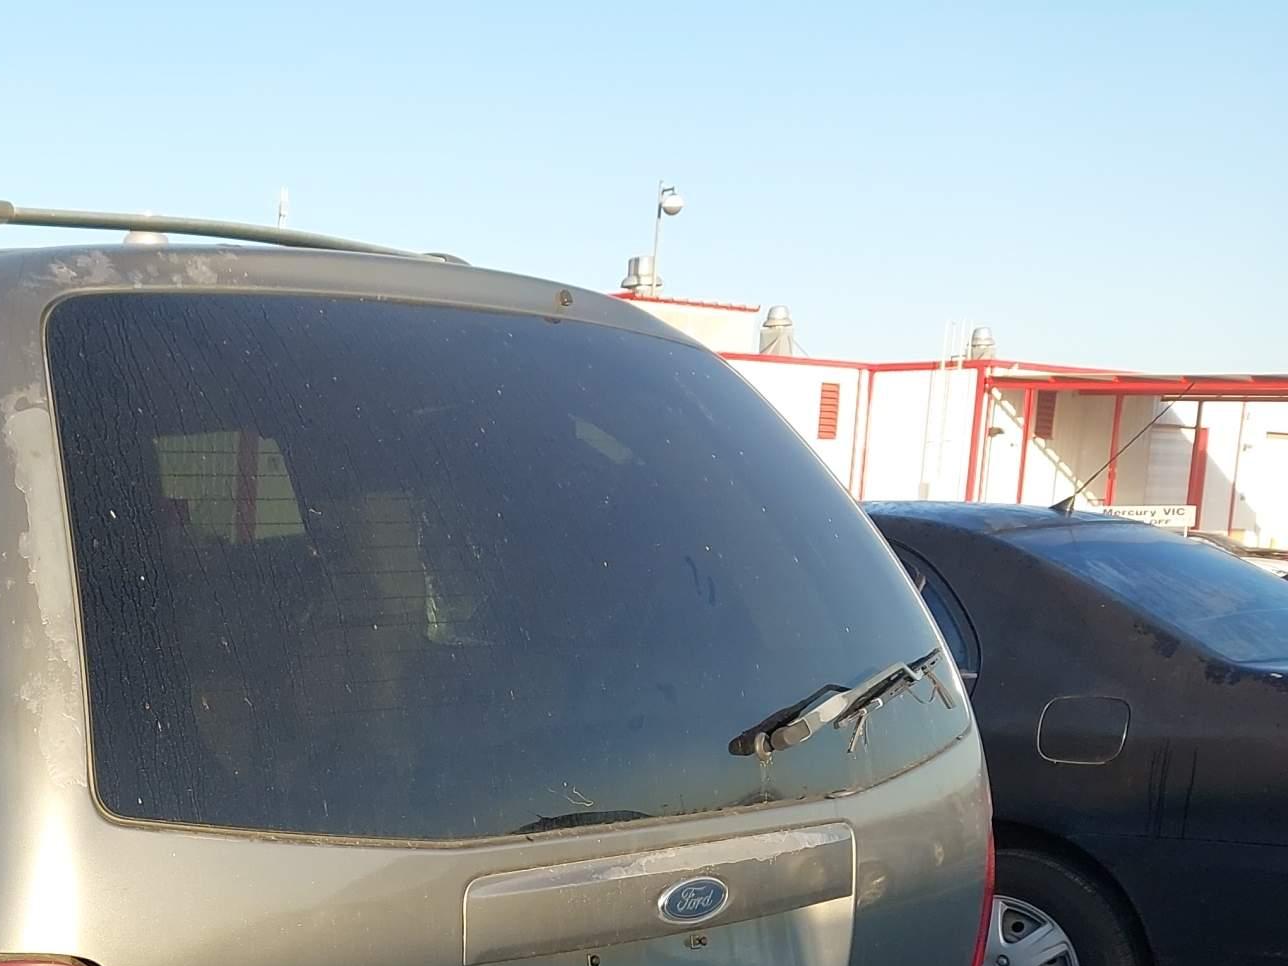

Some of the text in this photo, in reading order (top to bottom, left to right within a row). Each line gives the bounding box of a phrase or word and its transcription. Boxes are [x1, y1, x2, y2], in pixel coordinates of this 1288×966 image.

[1103, 508, 1186, 517] Mercury VIC
[676, 886, 714, 912] Ford
